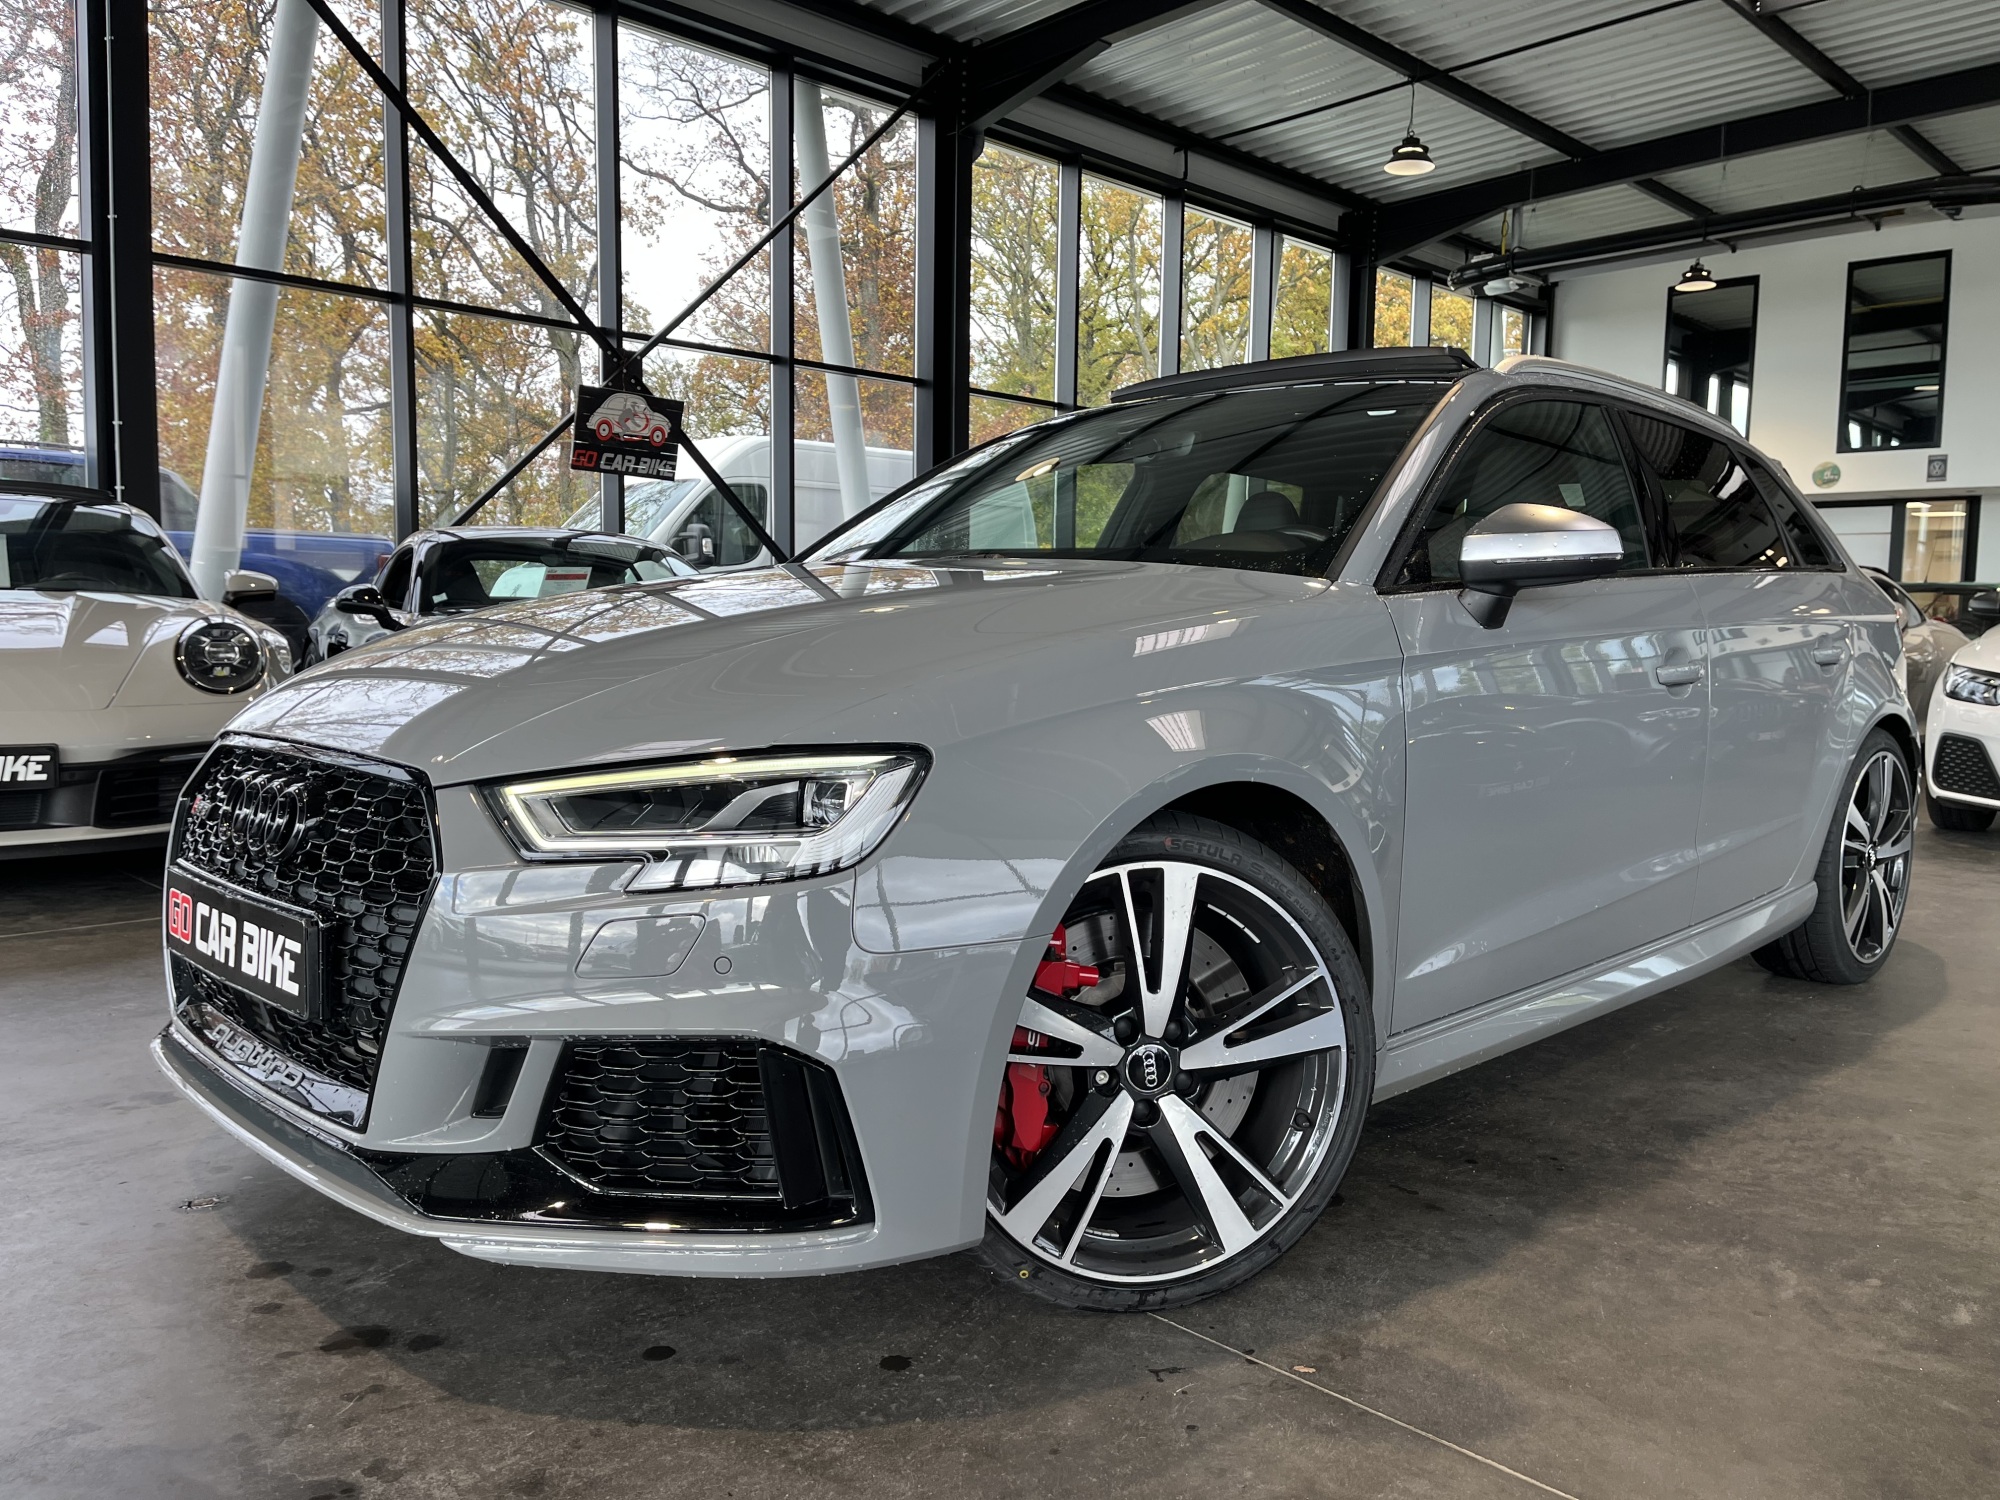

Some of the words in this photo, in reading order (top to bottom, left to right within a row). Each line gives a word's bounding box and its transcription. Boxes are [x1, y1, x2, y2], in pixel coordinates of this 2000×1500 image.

[572, 449, 598, 468] GO
[600, 452, 636, 472] CAR
[637, 457, 677, 478] BIKE
[168, 887, 193, 945] GO
[195, 901, 236, 968] CAR
[241, 920, 302, 996] BIKE
[211, 1023, 304, 1088] quattro
